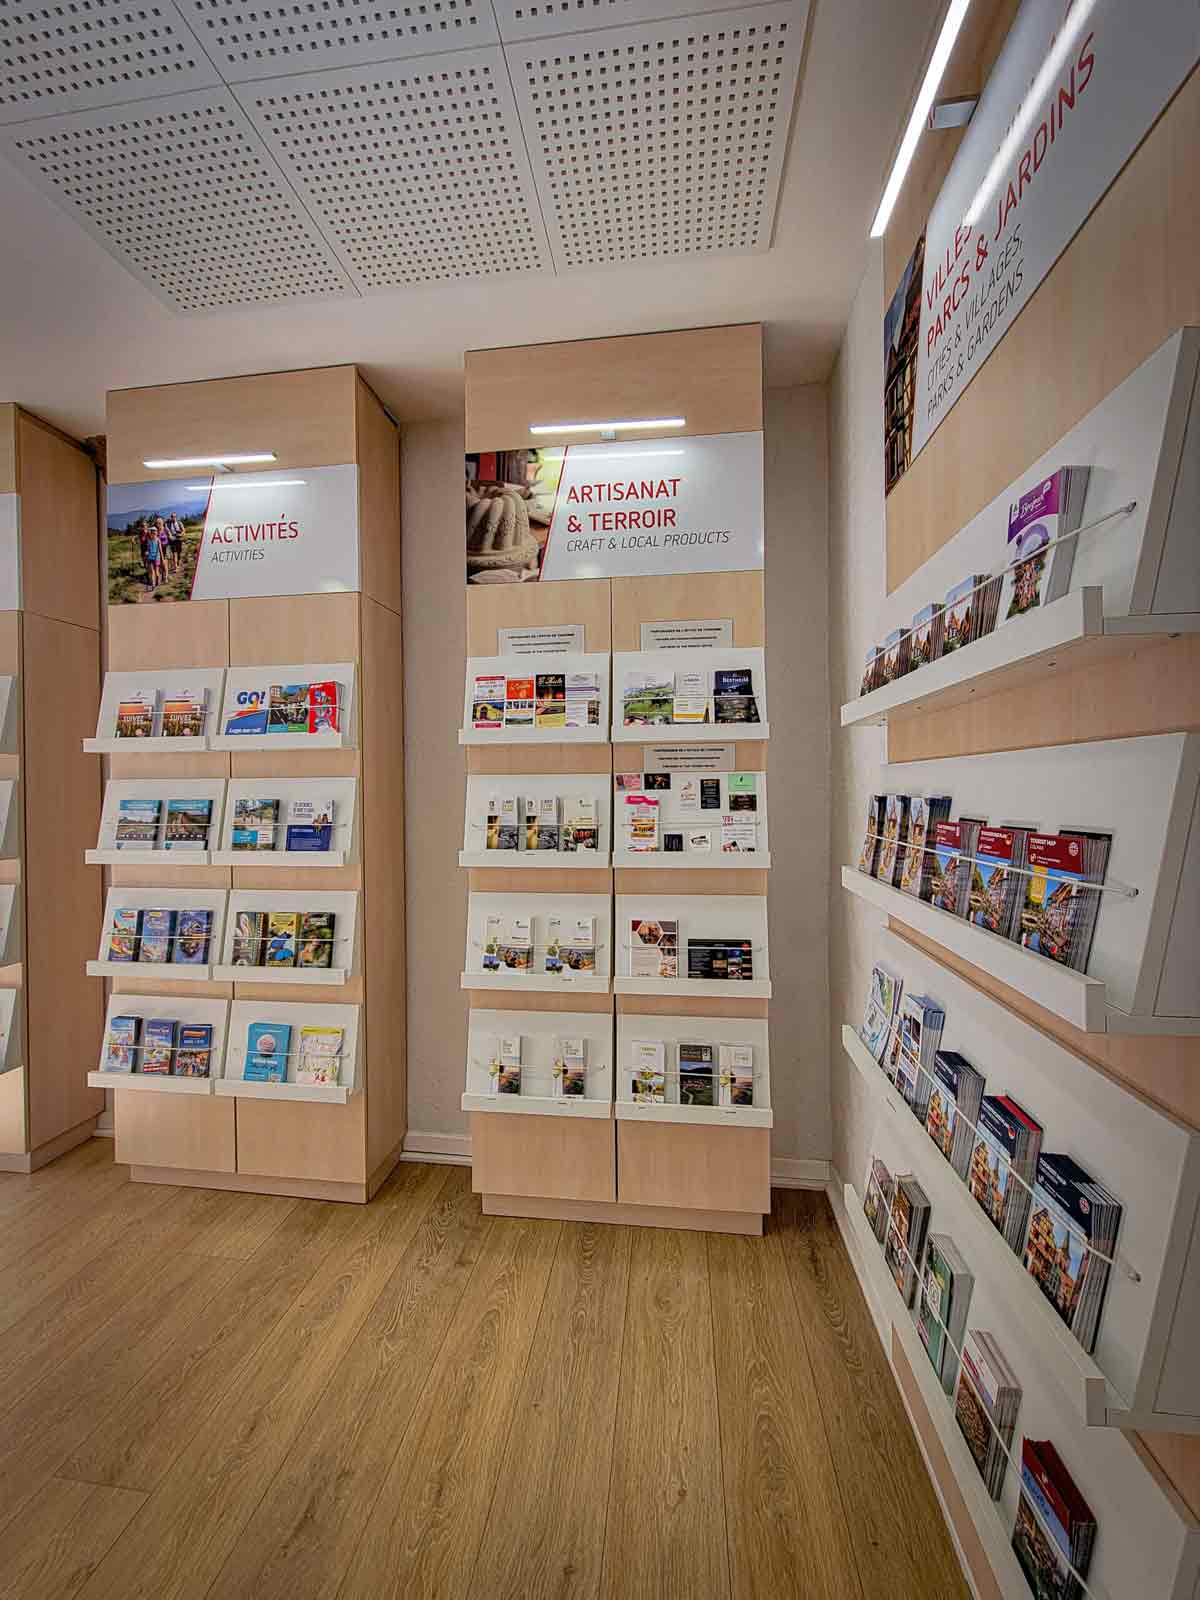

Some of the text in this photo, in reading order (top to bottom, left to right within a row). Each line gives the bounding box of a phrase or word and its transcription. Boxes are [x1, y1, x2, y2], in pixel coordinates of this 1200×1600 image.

[927, 260, 970, 358] PARCS
[976, 234, 989, 272] &
[995, 32, 1095, 240] JARDINS
[928, 223, 1023, 391] CITIES & VILLAGES,
[928, 259, 1025, 419] PARKS & GARDENS
[566, 478, 681, 504] ARTISANAT
[211, 513, 298, 544] ACTIVITÉS
[567, 508, 676, 532] & TERROIR
[566, 530, 731, 552] CRAFT & LOCAL PRODUCTS
[211, 549, 265, 563] ACTIVITIES
[237, 691, 266, 704] GO!
